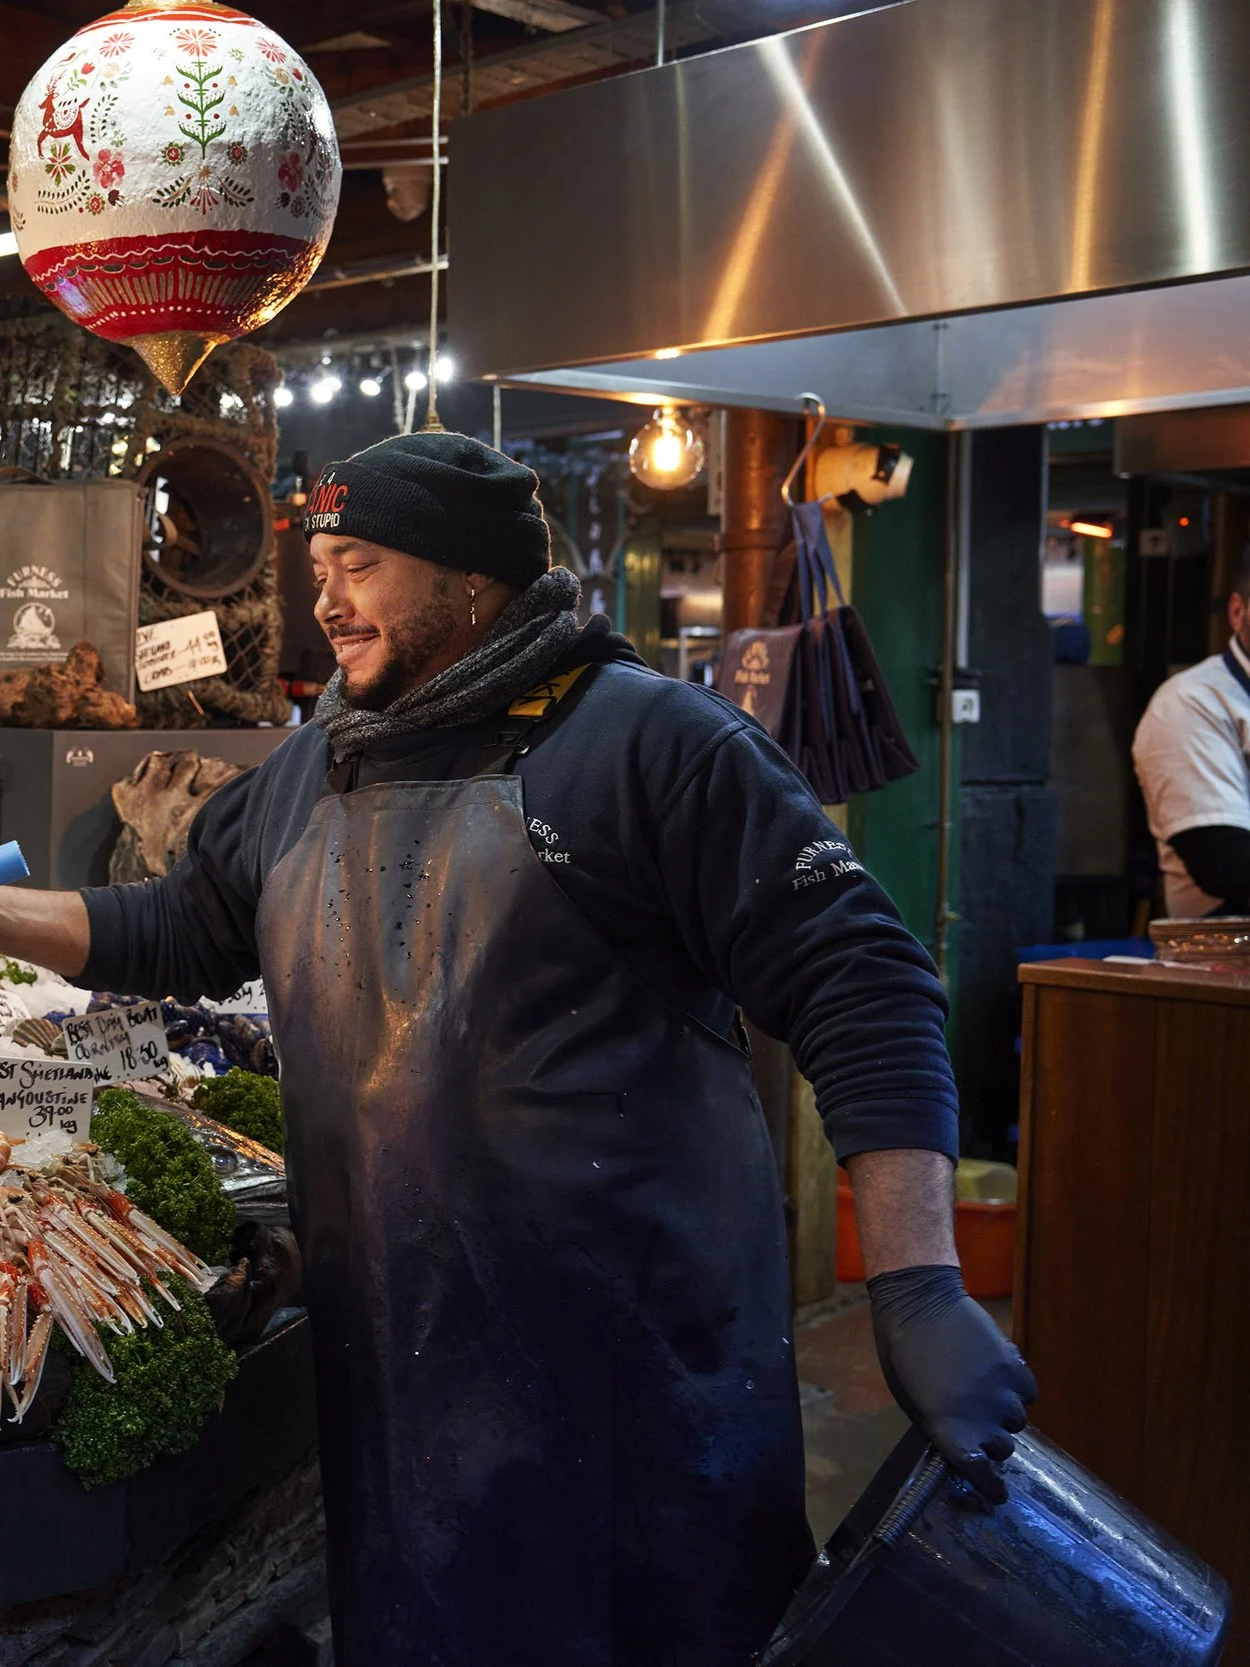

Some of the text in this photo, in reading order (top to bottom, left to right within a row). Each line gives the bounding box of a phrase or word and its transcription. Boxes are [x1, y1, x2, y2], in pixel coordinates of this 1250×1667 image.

[311, 512, 341, 529] STUPID
[27, 588, 69, 599] Market
[537, 847, 571, 864] rket
[790, 869, 827, 891] Fish
[66, 1019, 94, 1047] BEST
[126, 1006, 158, 1028] BOAT
[19, 1060, 93, 1089] SHETLAND
[60, 1119, 78, 1134] kg
